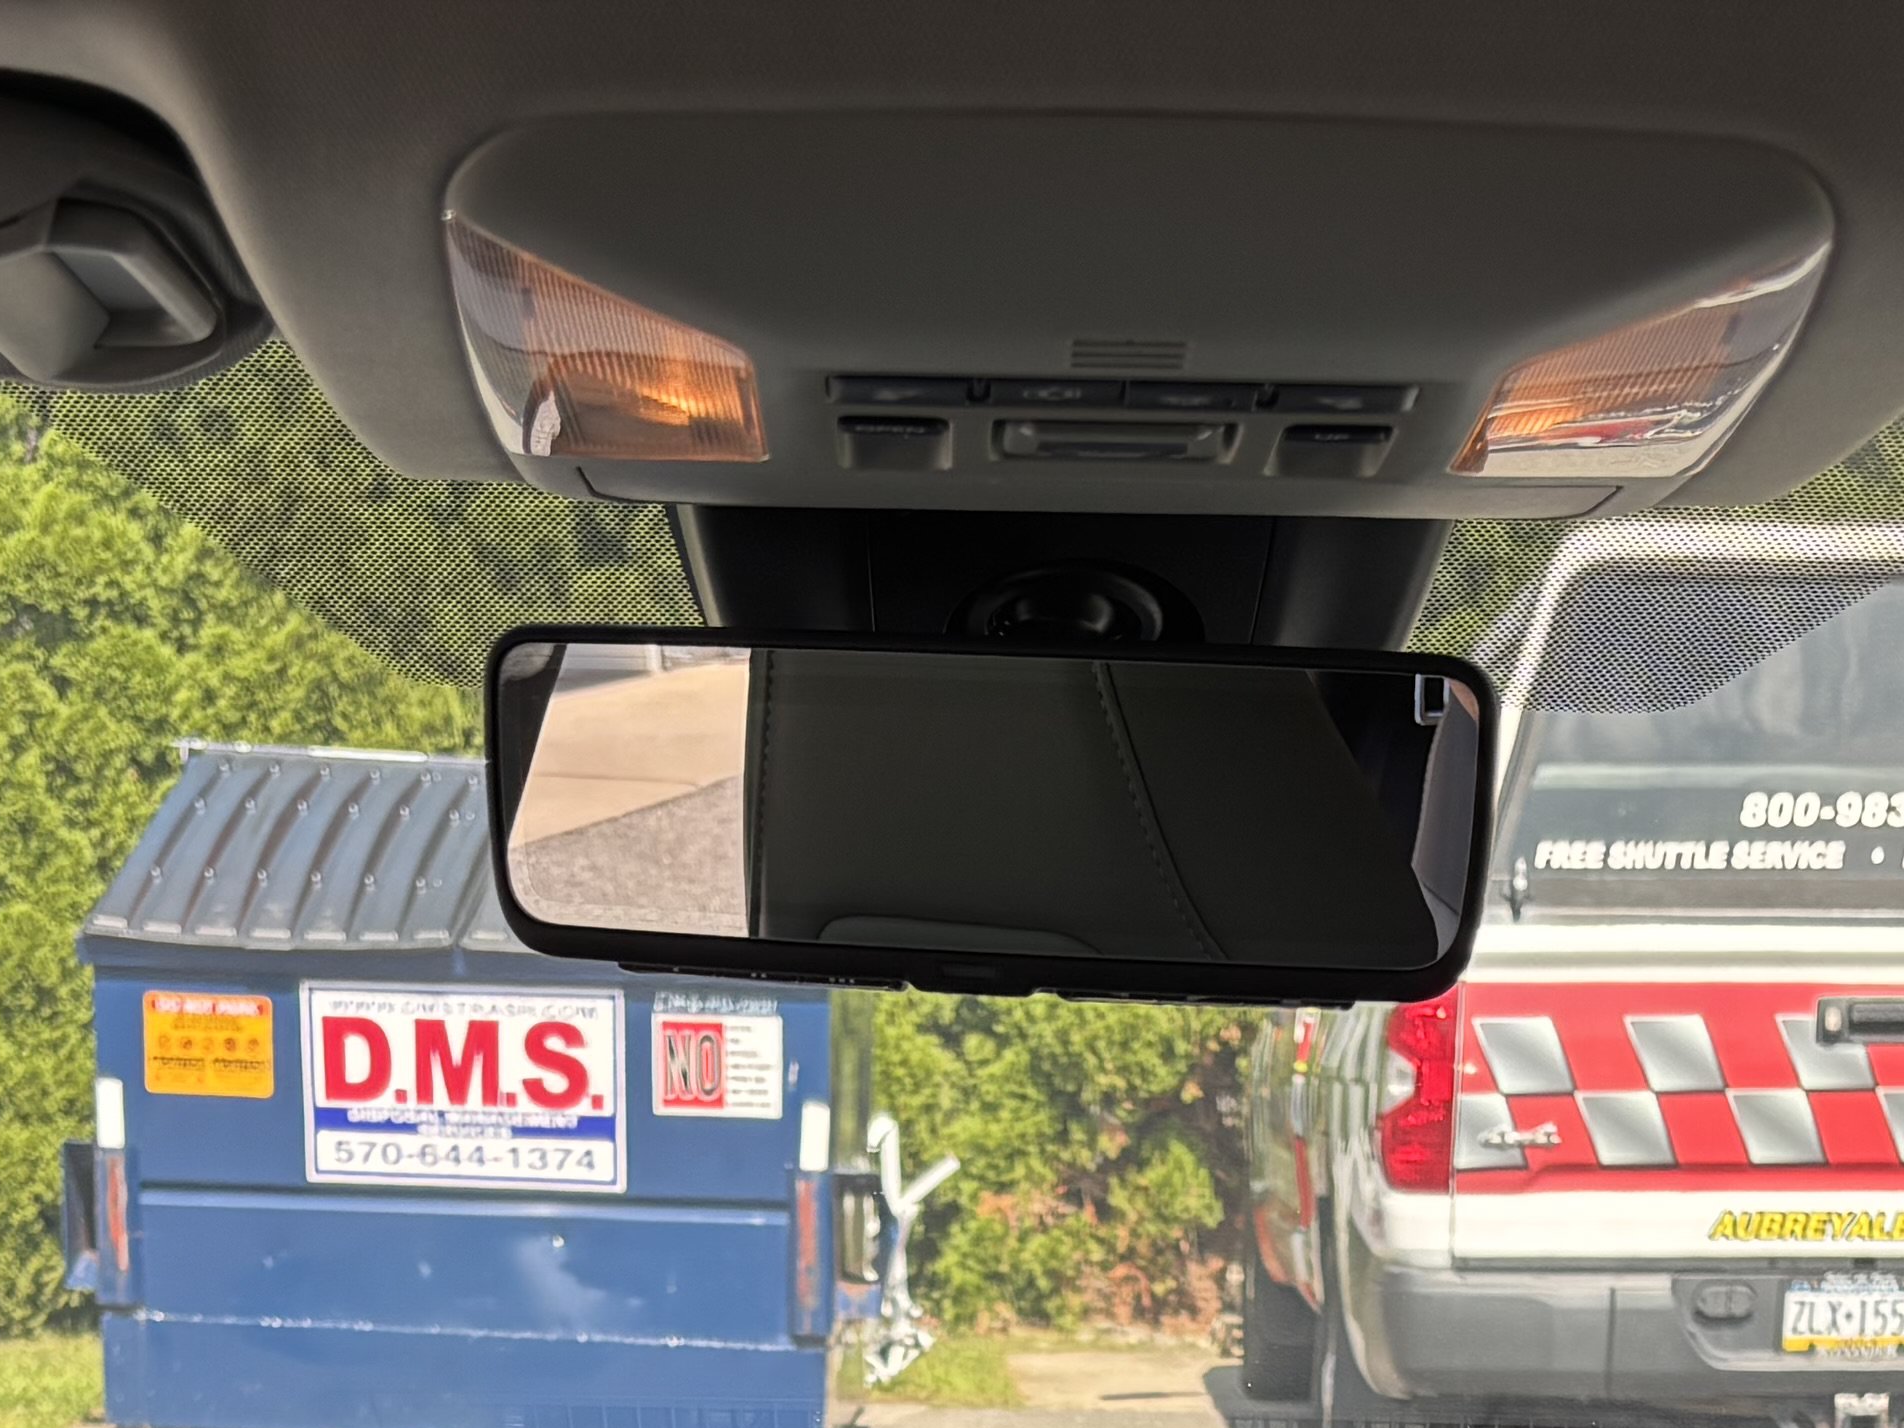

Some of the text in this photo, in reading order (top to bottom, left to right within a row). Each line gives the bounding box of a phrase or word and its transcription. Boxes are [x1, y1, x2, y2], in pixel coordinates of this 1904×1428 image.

[1535, 841, 1605, 868] FREE
[1607, 841, 1728, 869] SHUTTLE
[1730, 841, 1846, 870] SERVICE
[322, 1016, 604, 1110] D.M.S.
[664, 1028, 723, 1101] NO
[334, 1141, 596, 1171] 570-644-1374
